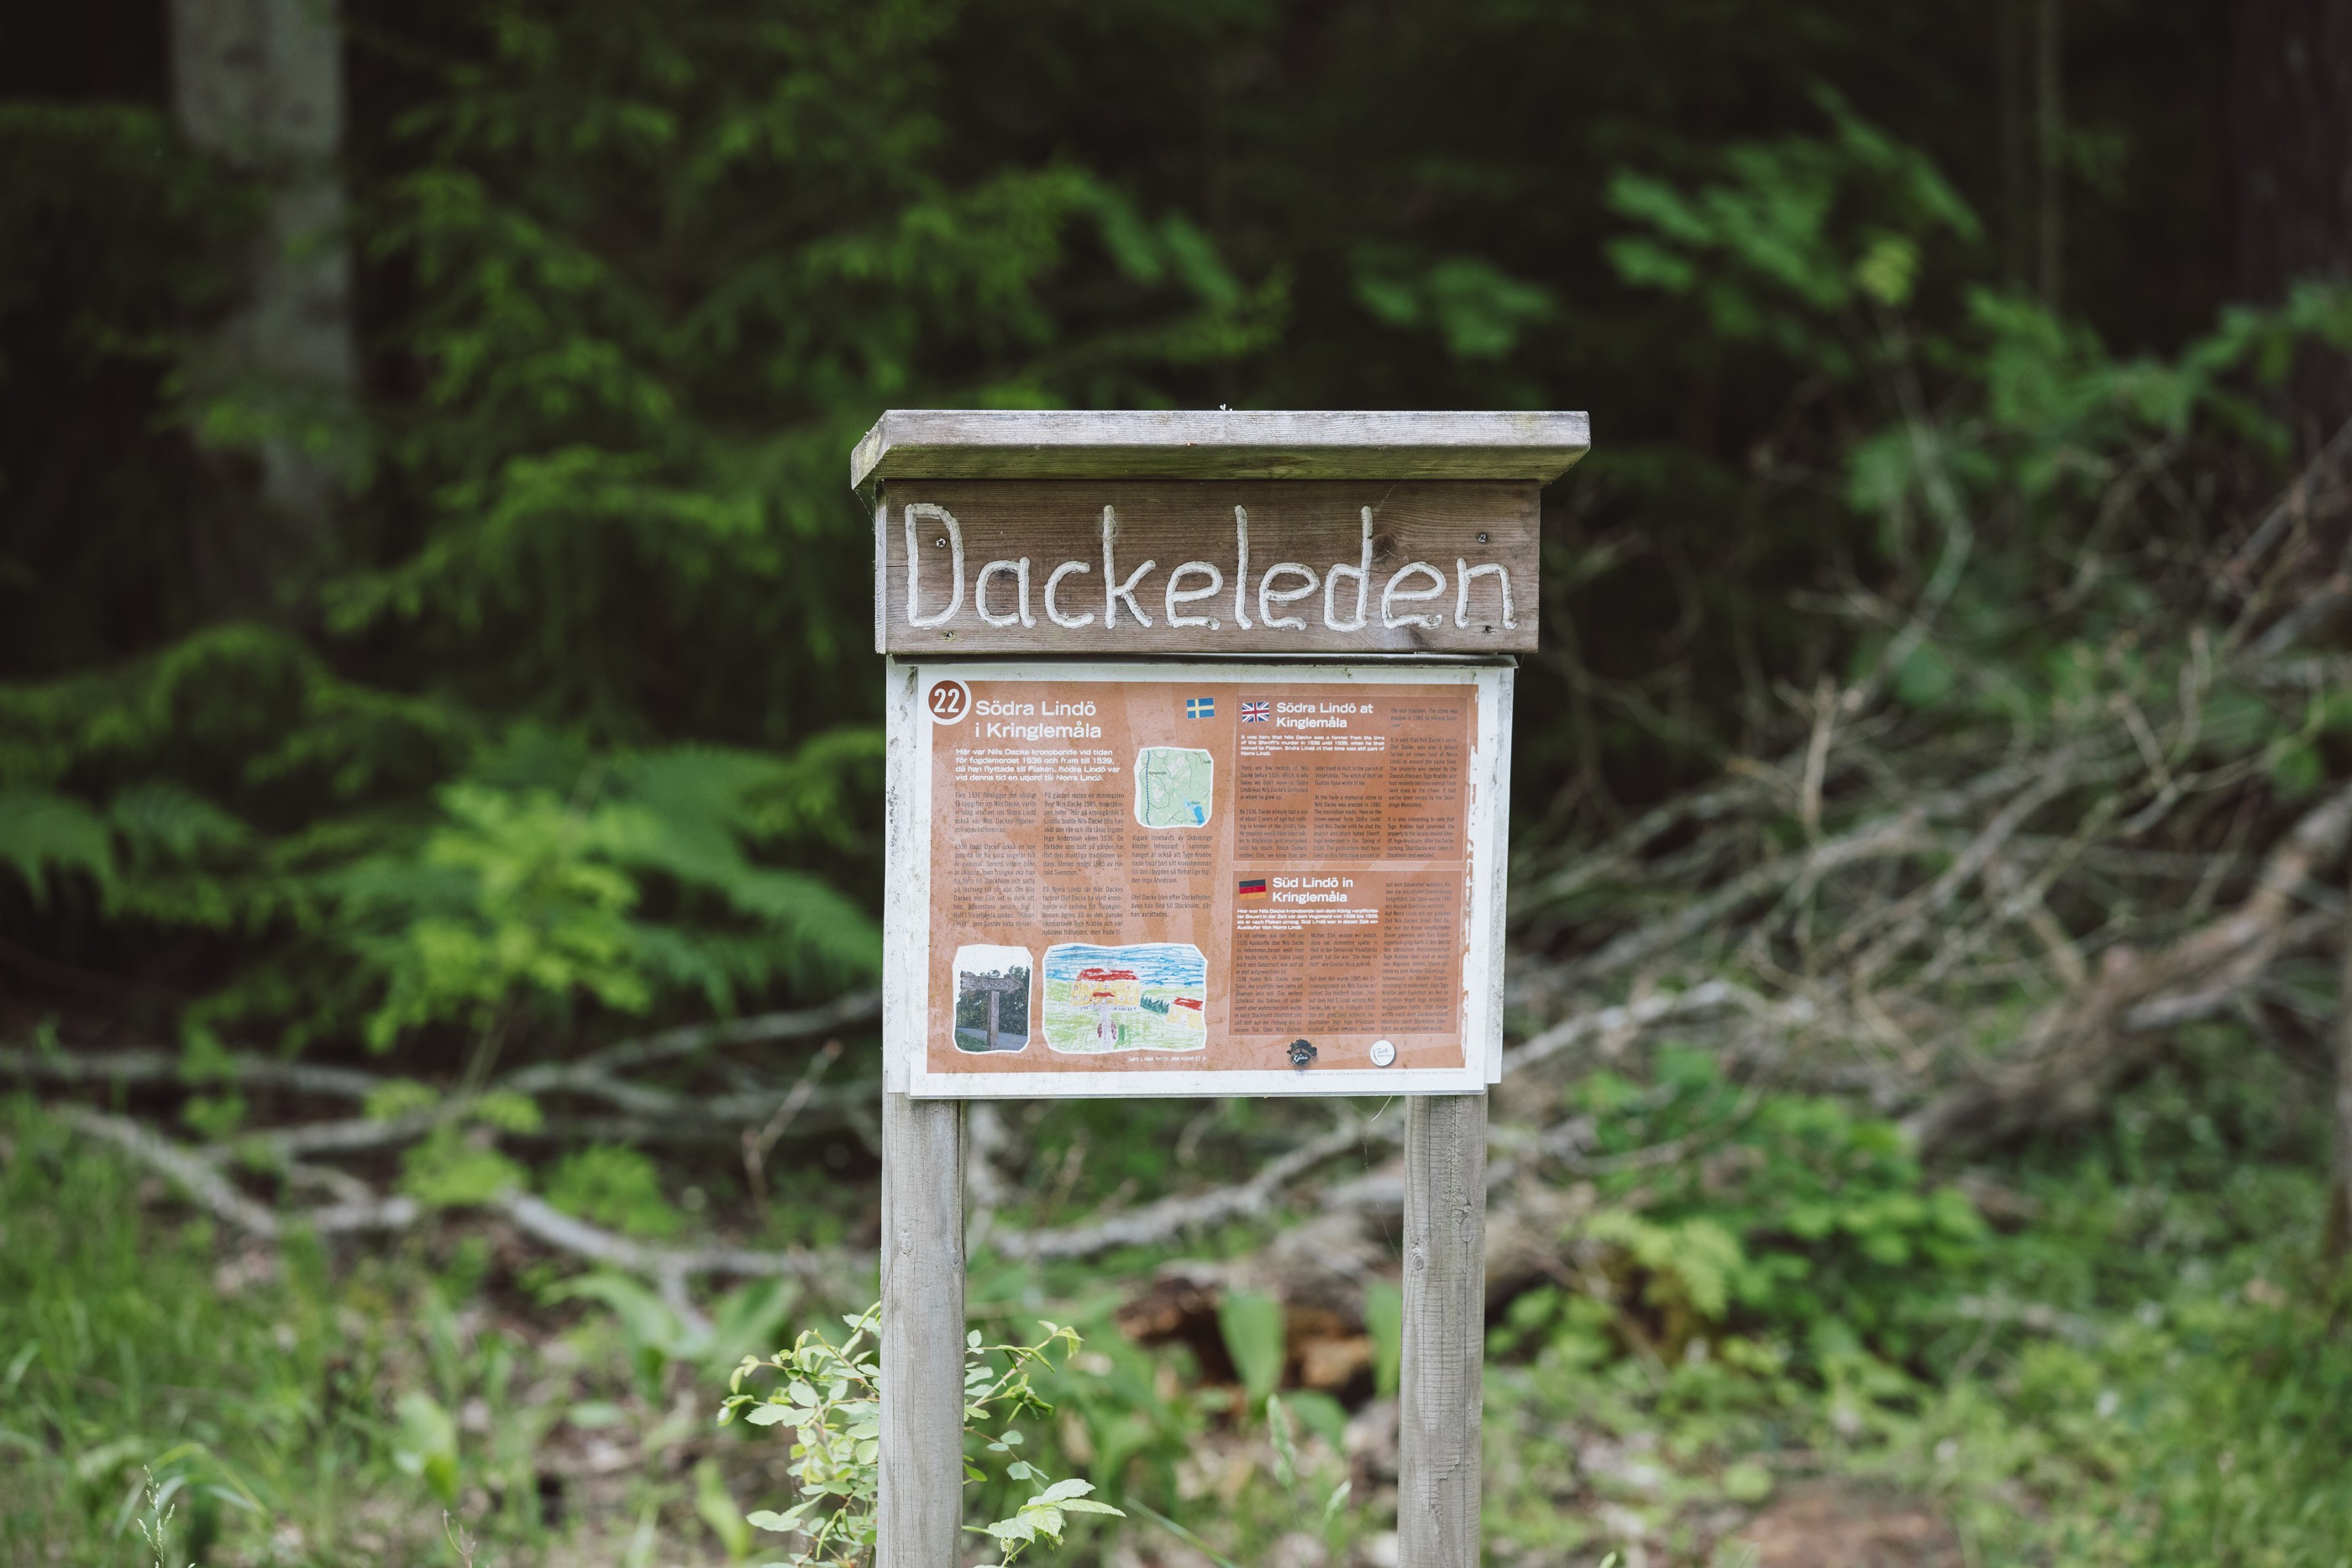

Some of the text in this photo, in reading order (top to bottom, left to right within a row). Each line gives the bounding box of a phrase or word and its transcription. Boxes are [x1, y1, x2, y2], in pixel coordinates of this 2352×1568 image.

[905, 502, 1517, 632] Dackeleden
[933, 688, 960, 713] 22
[975, 700, 1096, 716] Södra Lindö
[1276, 702, 1373, 714] Södra Lindö at
[1277, 716, 1347, 729] Kinglemåla
[975, 721, 1101, 742] i Kringlemåla
[1273, 877, 1353, 888] Süd Lindö in
[1272, 891, 1347, 904] Kringlemåla
